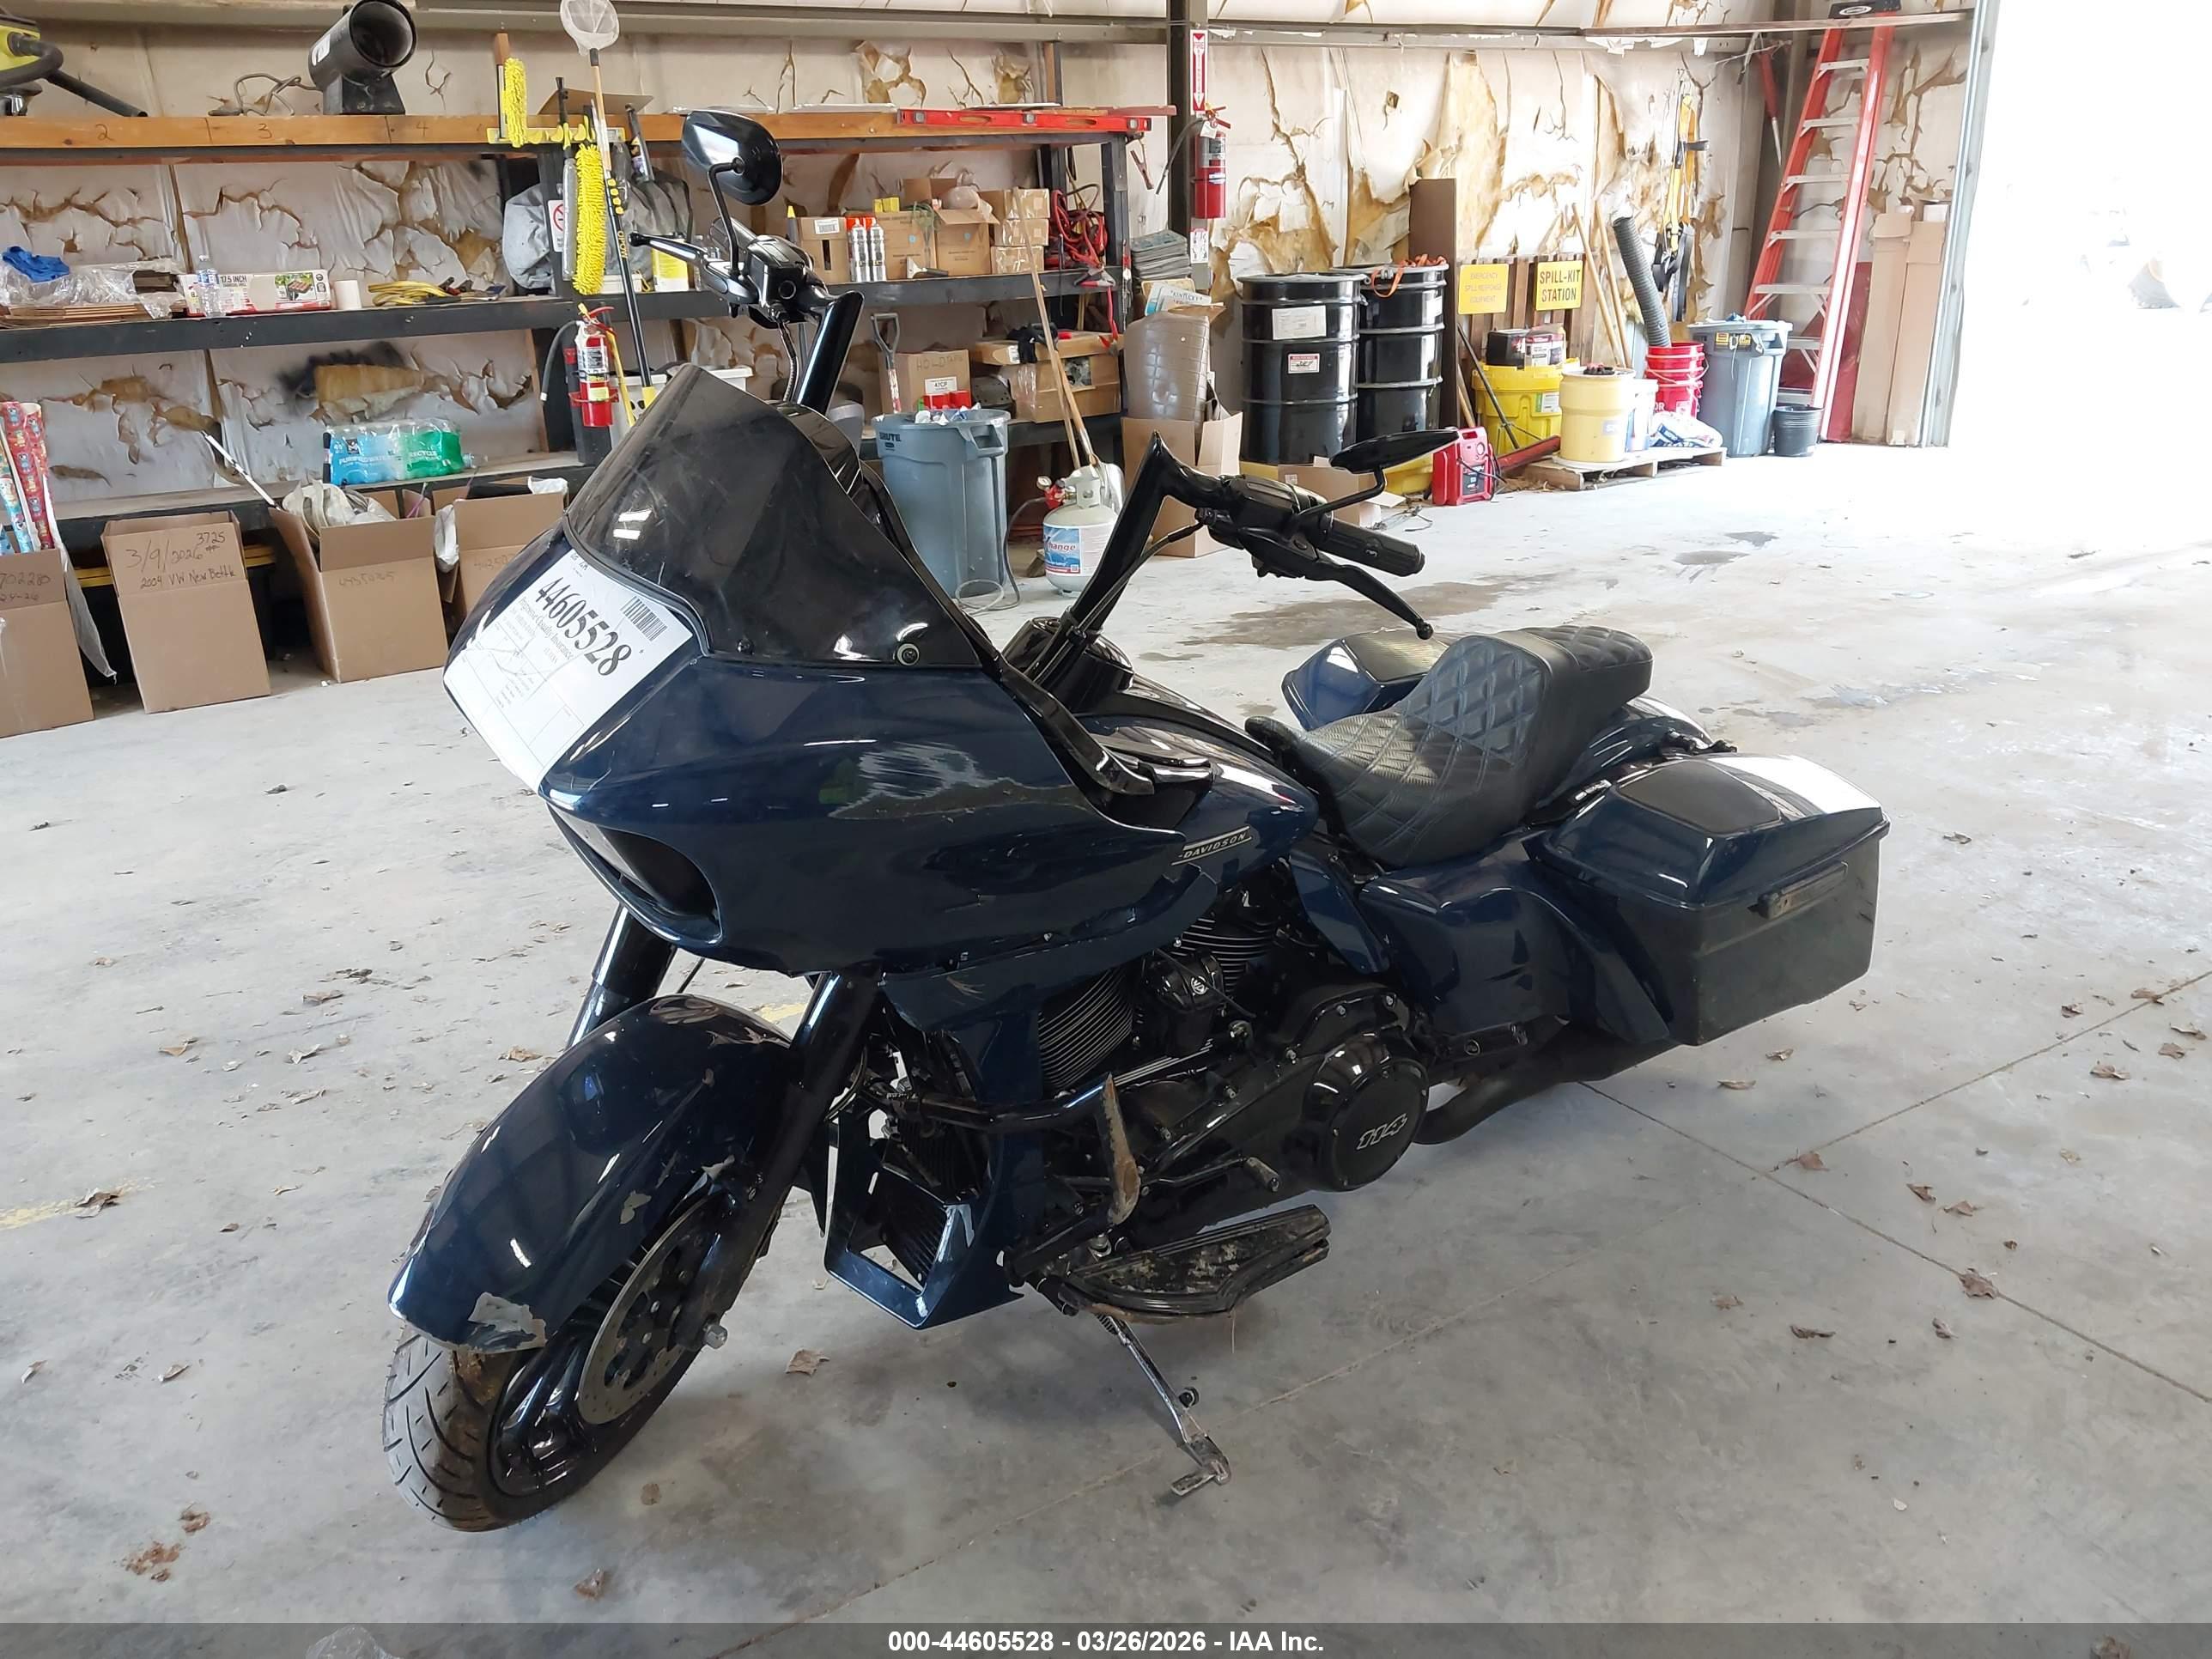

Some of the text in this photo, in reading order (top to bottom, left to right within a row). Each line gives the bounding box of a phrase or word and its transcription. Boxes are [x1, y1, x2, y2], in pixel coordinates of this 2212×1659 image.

[95, 123, 114, 142] 2
[257, 122, 272, 140] 3
[416, 121, 428, 137] 4
[220, 275, 247, 283] 17.5 INCH
[1540, 269, 1581, 284] SPILL-KIT
[1541, 288, 1577, 302] STATION
[125, 538, 204, 573] 3/9/2026
[169, 574, 186, 586] VW
[188, 571, 208, 584] New
[535, 576, 632, 676] 44605528
[1357, 1113, 1408, 1151] 114
